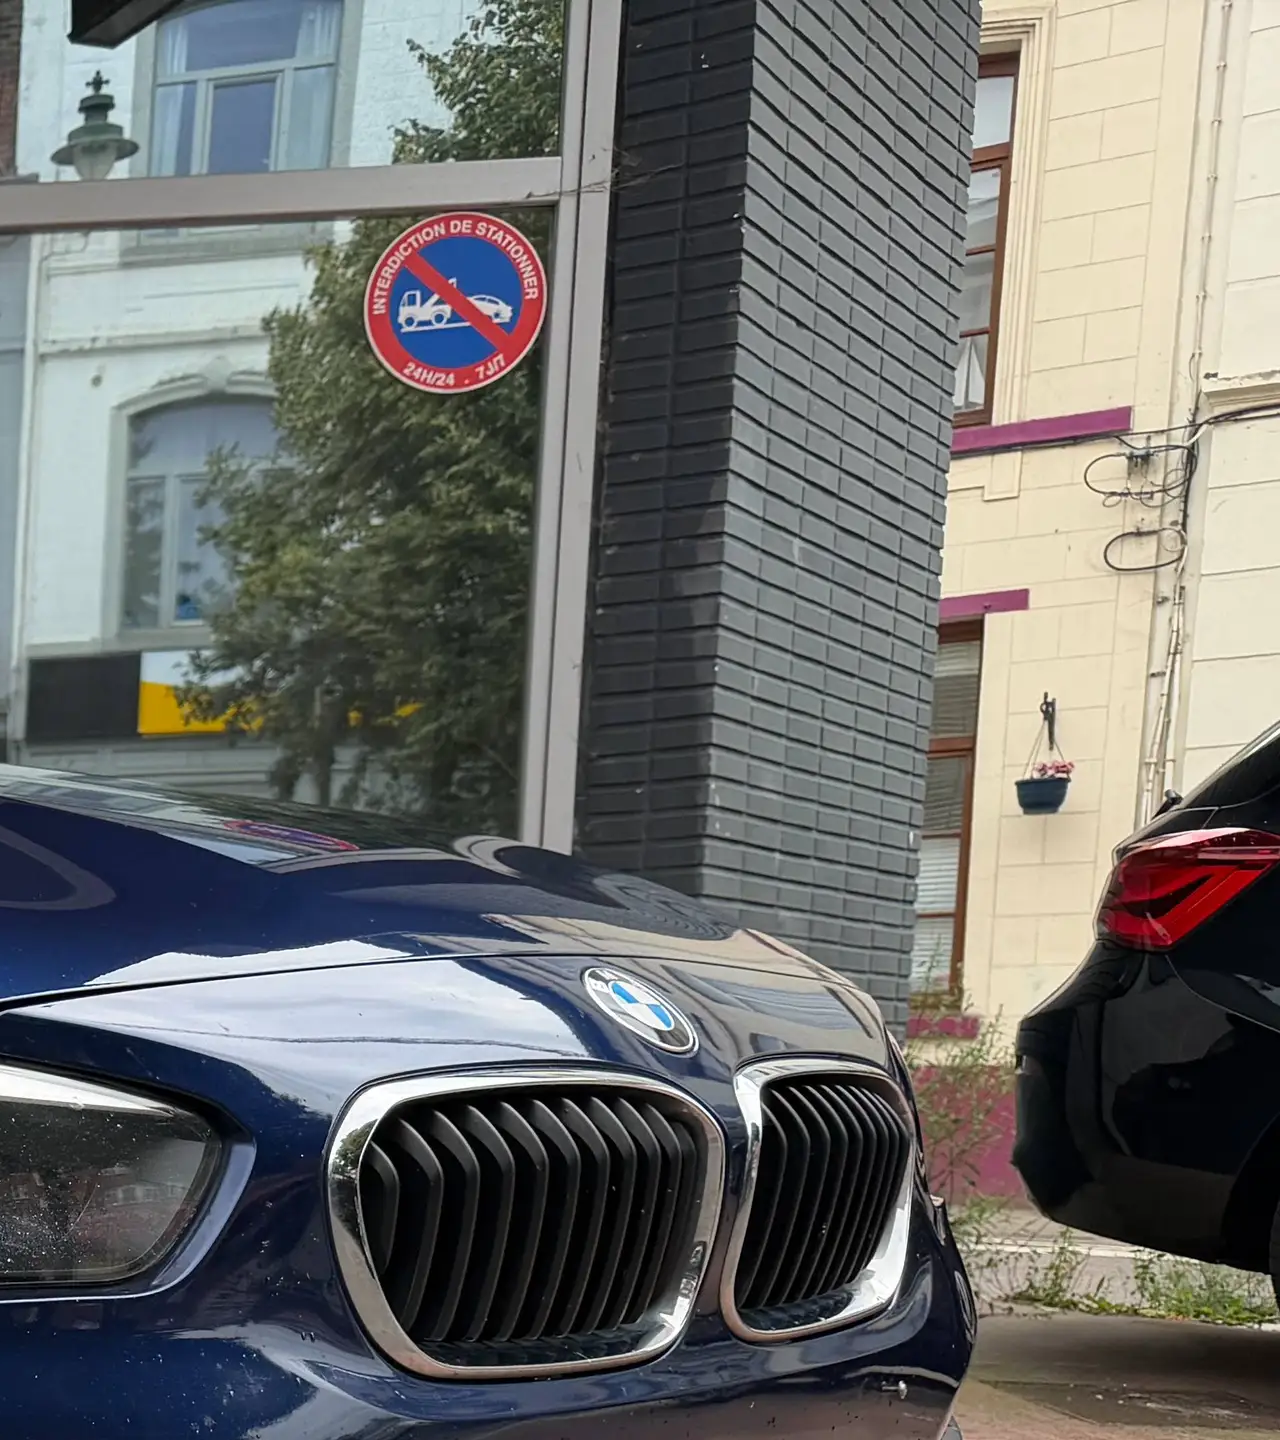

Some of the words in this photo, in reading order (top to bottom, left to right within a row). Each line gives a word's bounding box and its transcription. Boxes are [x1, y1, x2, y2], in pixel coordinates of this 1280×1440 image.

[373, 221, 446, 315] INTERDICTION
[450, 219, 473, 234] DE
[476, 221, 539, 300] STATIONNER
[403, 361, 455, 387] 24H/24
